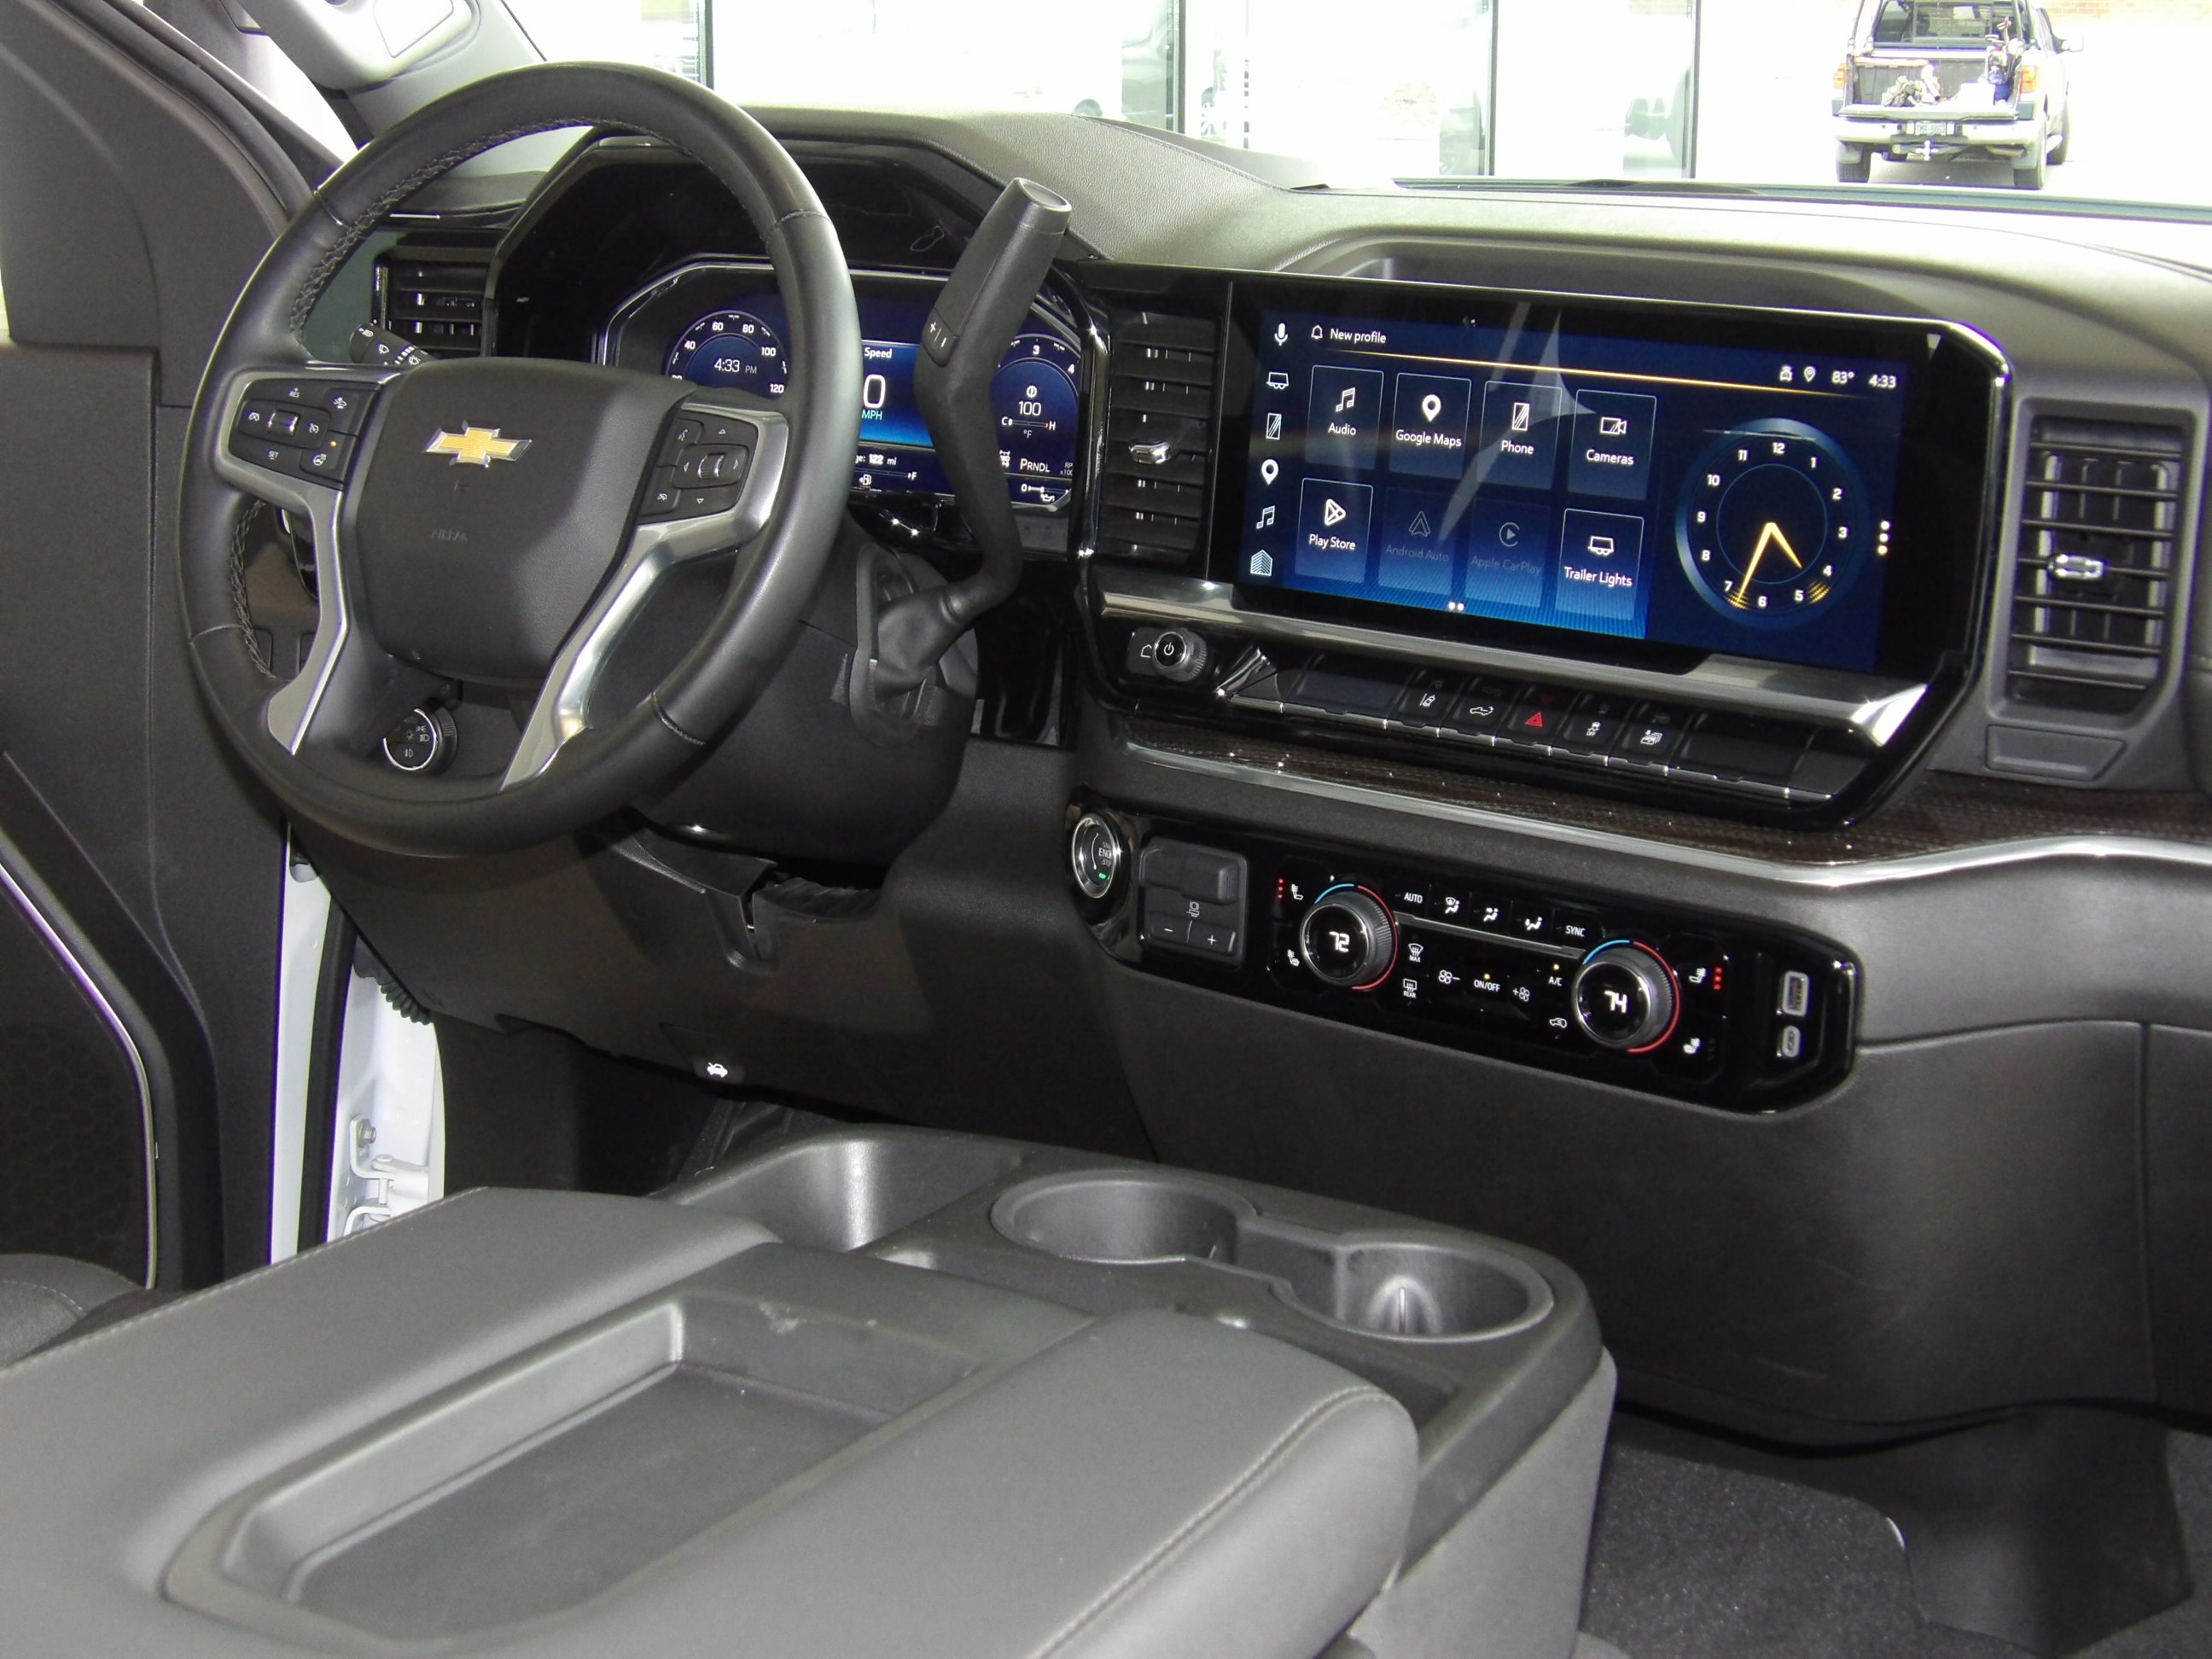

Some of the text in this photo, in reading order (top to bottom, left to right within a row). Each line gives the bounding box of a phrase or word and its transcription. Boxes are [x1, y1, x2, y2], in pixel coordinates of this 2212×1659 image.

[713, 322, 724, 331] 60
[742, 324, 754, 334] 80
[1330, 329, 1387, 345] New profile
[684, 341, 696, 350] 40
[761, 346, 777, 357] 100
[1033, 345, 1040, 355] 3
[864, 347, 893, 358] Speed
[714, 358, 757, 375] 4:33 PM
[1068, 364, 1075, 374] 4
[1869, 374, 1897, 389] 4:33
[770, 384, 784, 393] 120
[863, 374, 886, 409] 0
[1018, 401, 1042, 416] 100
[862, 410, 883, 421] MPH
[1001, 416, 1009, 426] C
[1048, 421, 1057, 431] H
[1328, 422, 1357, 436] Audio
[1395, 429, 1462, 449] Google Maps
[1501, 439, 1534, 454] Phone
[1773, 442, 1785, 455] 12
[869, 453, 884, 465] 122
[887, 457, 898, 466] mi
[1586, 449, 1634, 465] Cameras
[1738, 449, 1748, 462] 11
[1810, 457, 1816, 469] 1
[1708, 474, 1720, 486] 10
[1832, 487, 1842, 500] 2
[1697, 510, 1706, 523] 9
[1838, 526, 1848, 538] 3
[1309, 533, 1357, 551] Play Store
[1386, 544, 1449, 562] Android Auto
[1701, 550, 1710, 562] 8
[1471, 556, 1541, 575] Apple CarPlay
[1823, 565, 1832, 577] 4
[1564, 566, 1633, 588] Trailer Lights
[1724, 580, 1733, 591] 7
[1757, 596, 1767, 608] 6
[1795, 590, 1804, 602] 5
[1404, 892, 1423, 904] AUTO
[1565, 924, 1586, 937] SYNC
[1329, 931, 1350, 953] 72
[1474, 979, 1501, 992] ON/OFF
[1548, 975, 1563, 987] A/C
[1403, 990, 1417, 999] REAR
[1604, 990, 1627, 1014] 74
